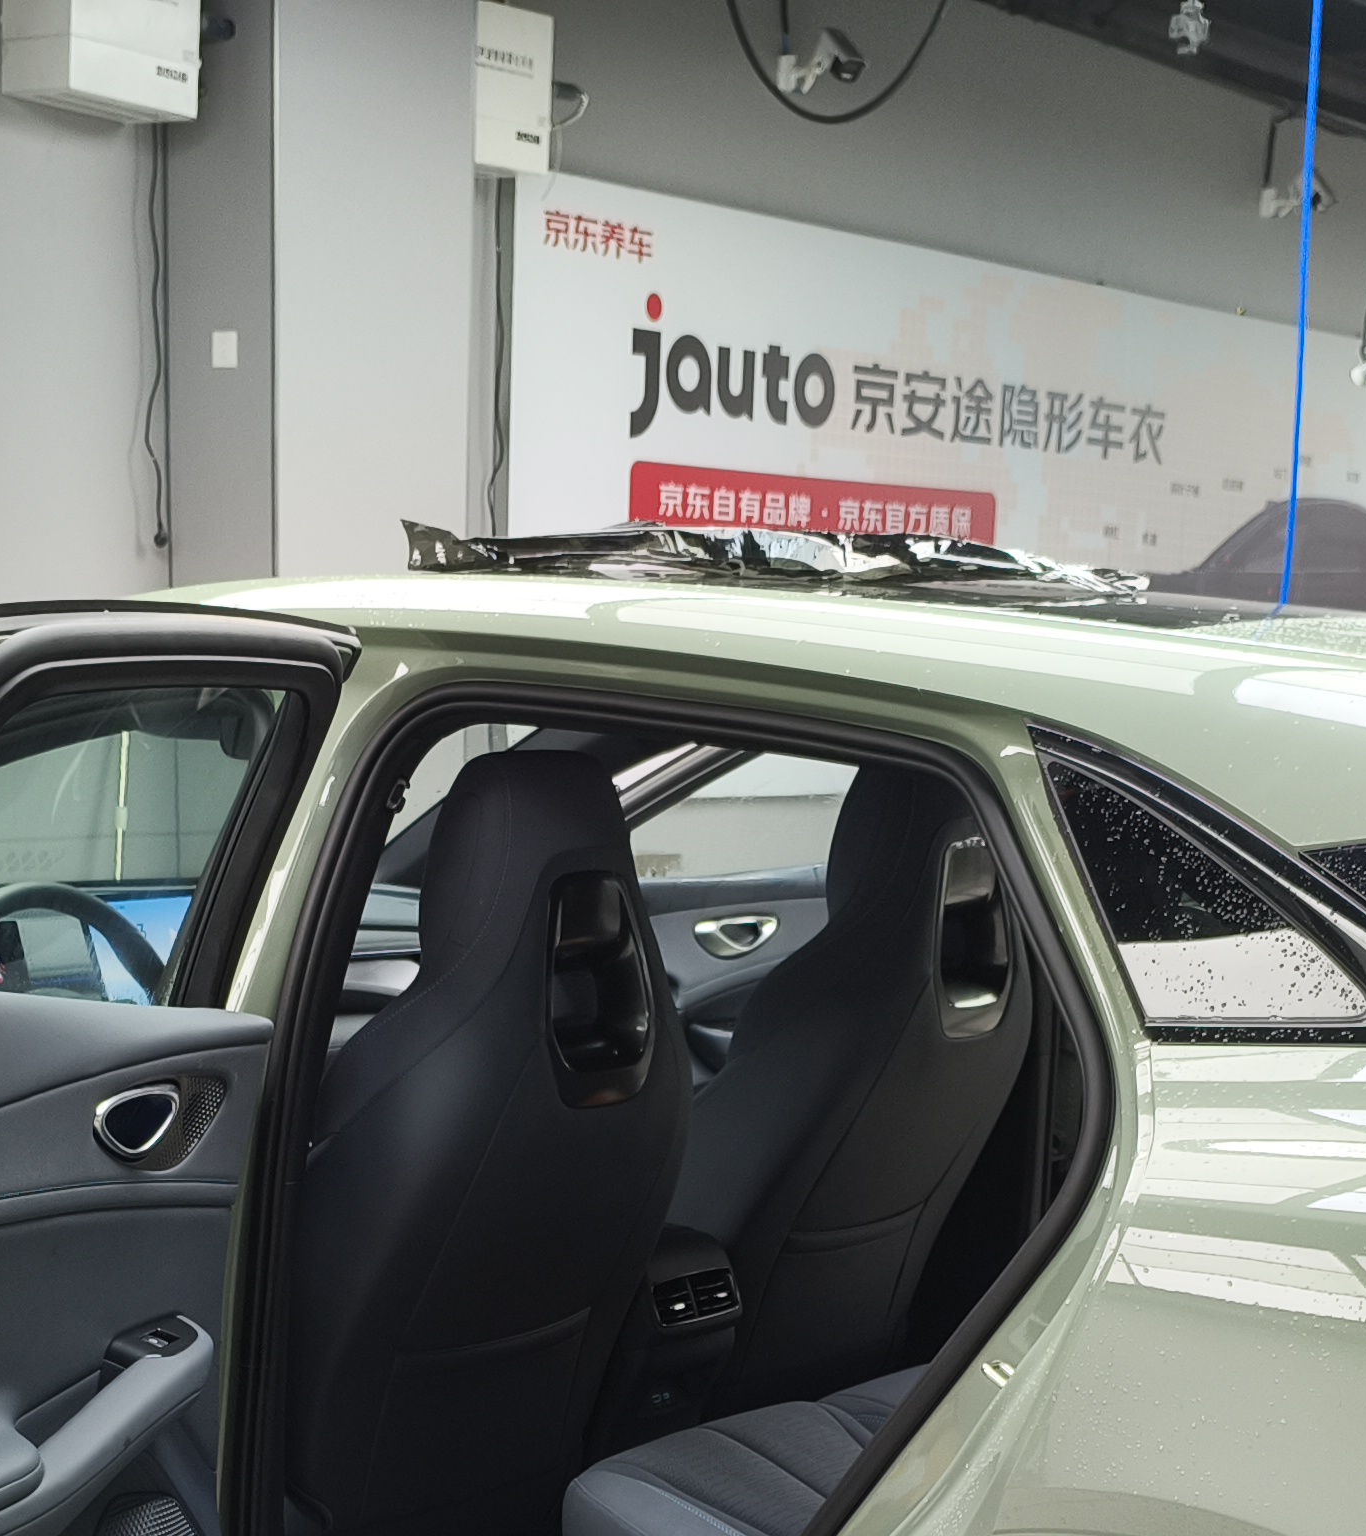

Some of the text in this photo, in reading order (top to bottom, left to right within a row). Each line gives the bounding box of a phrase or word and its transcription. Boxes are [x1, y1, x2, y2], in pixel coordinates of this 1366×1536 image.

[543, 210, 654, 264] 京东养车
[629, 292, 1168, 465] jauto 京安途隐形车衣
